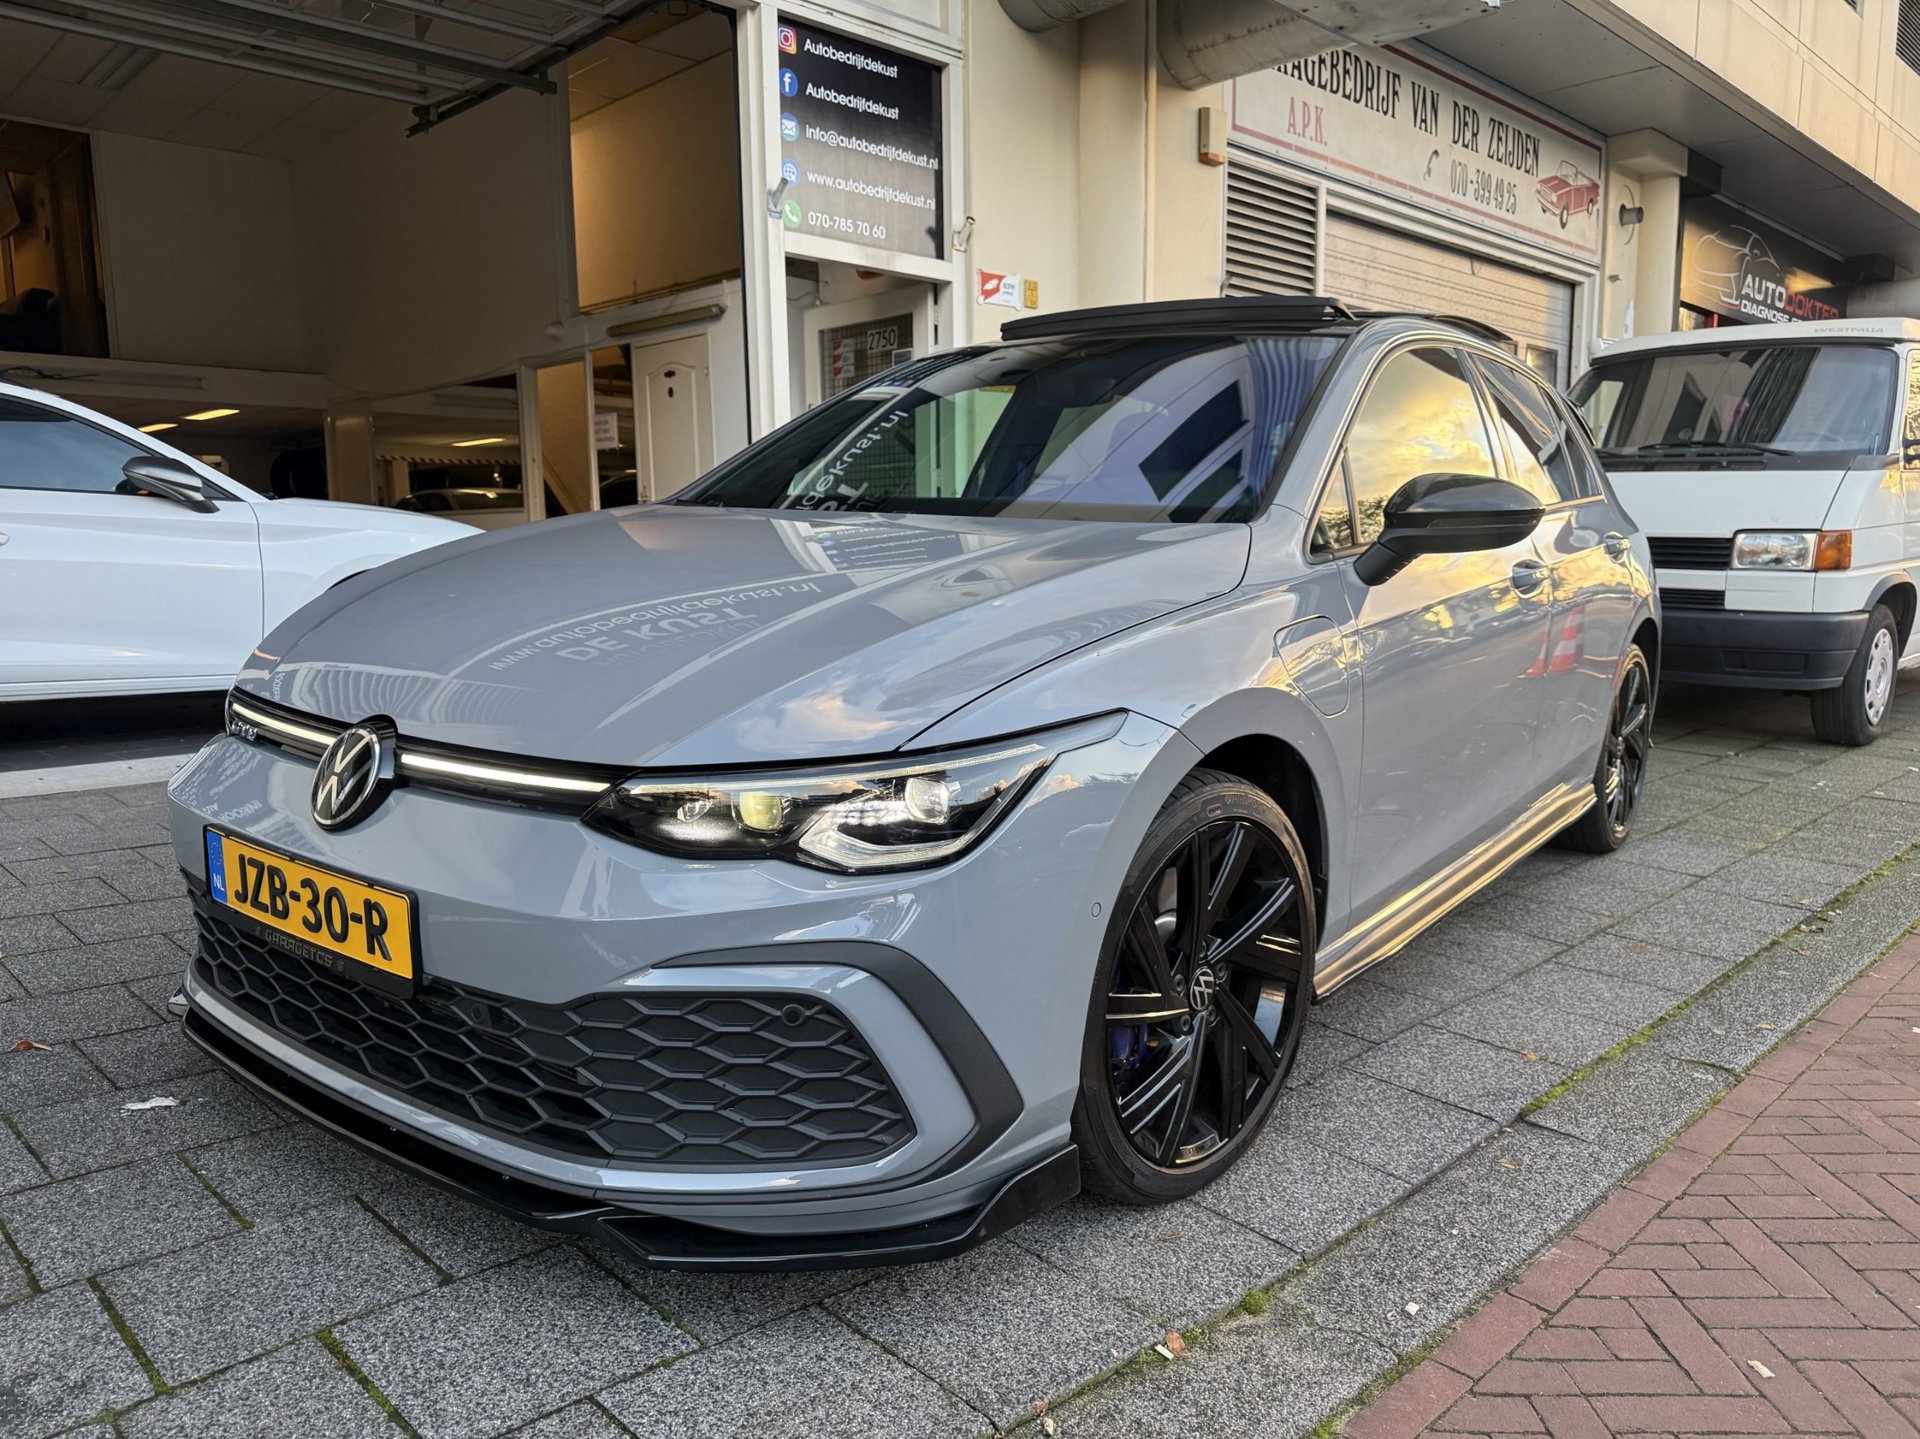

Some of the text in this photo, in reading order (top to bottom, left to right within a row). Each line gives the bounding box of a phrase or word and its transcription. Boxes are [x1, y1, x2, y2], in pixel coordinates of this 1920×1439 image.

[804, 38, 899, 79] Autobedrijfdekust
[805, 82, 899, 121] Autobedrijfdekust
[1287, 96, 1328, 147] A.P.K.
[805, 124, 939, 171] info@autobedrijfdekust.nl
[1411, 81, 1440, 137] VAN
[1452, 100, 1479, 153] DER
[1487, 116, 1541, 178] ZEIJDEN
[806, 171, 937, 211] www.autobedrijfdekust.nl
[1493, 176, 1505, 210] 49
[1506, 181, 1517, 215] 25
[808, 211, 886, 240] 070-785 70 60
[868, 328, 896, 351] 2750
[213, 874, 225, 892] NL
[234, 853, 393, 962] JZB-30-R
